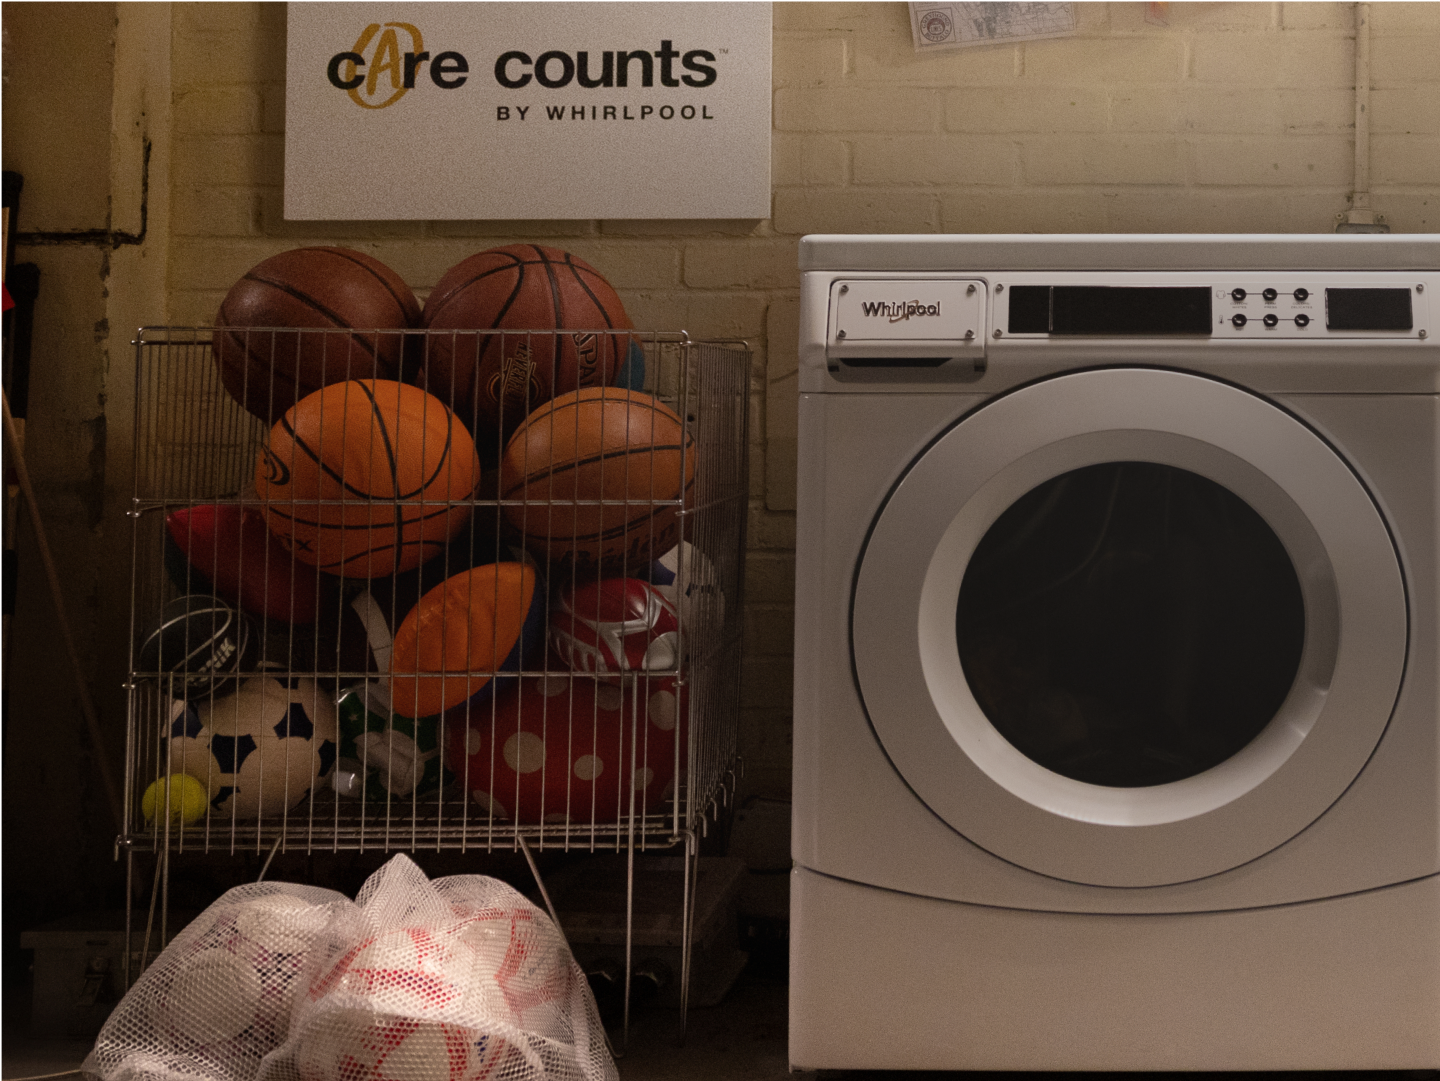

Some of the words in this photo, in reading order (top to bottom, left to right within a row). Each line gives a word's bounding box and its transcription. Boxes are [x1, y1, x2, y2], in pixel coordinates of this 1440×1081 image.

[494, 39, 718, 90] counts
[496, 106, 530, 121] BY
[546, 105, 715, 121] WHIRLPOOL
[862, 300, 941, 321] Whirlpool
